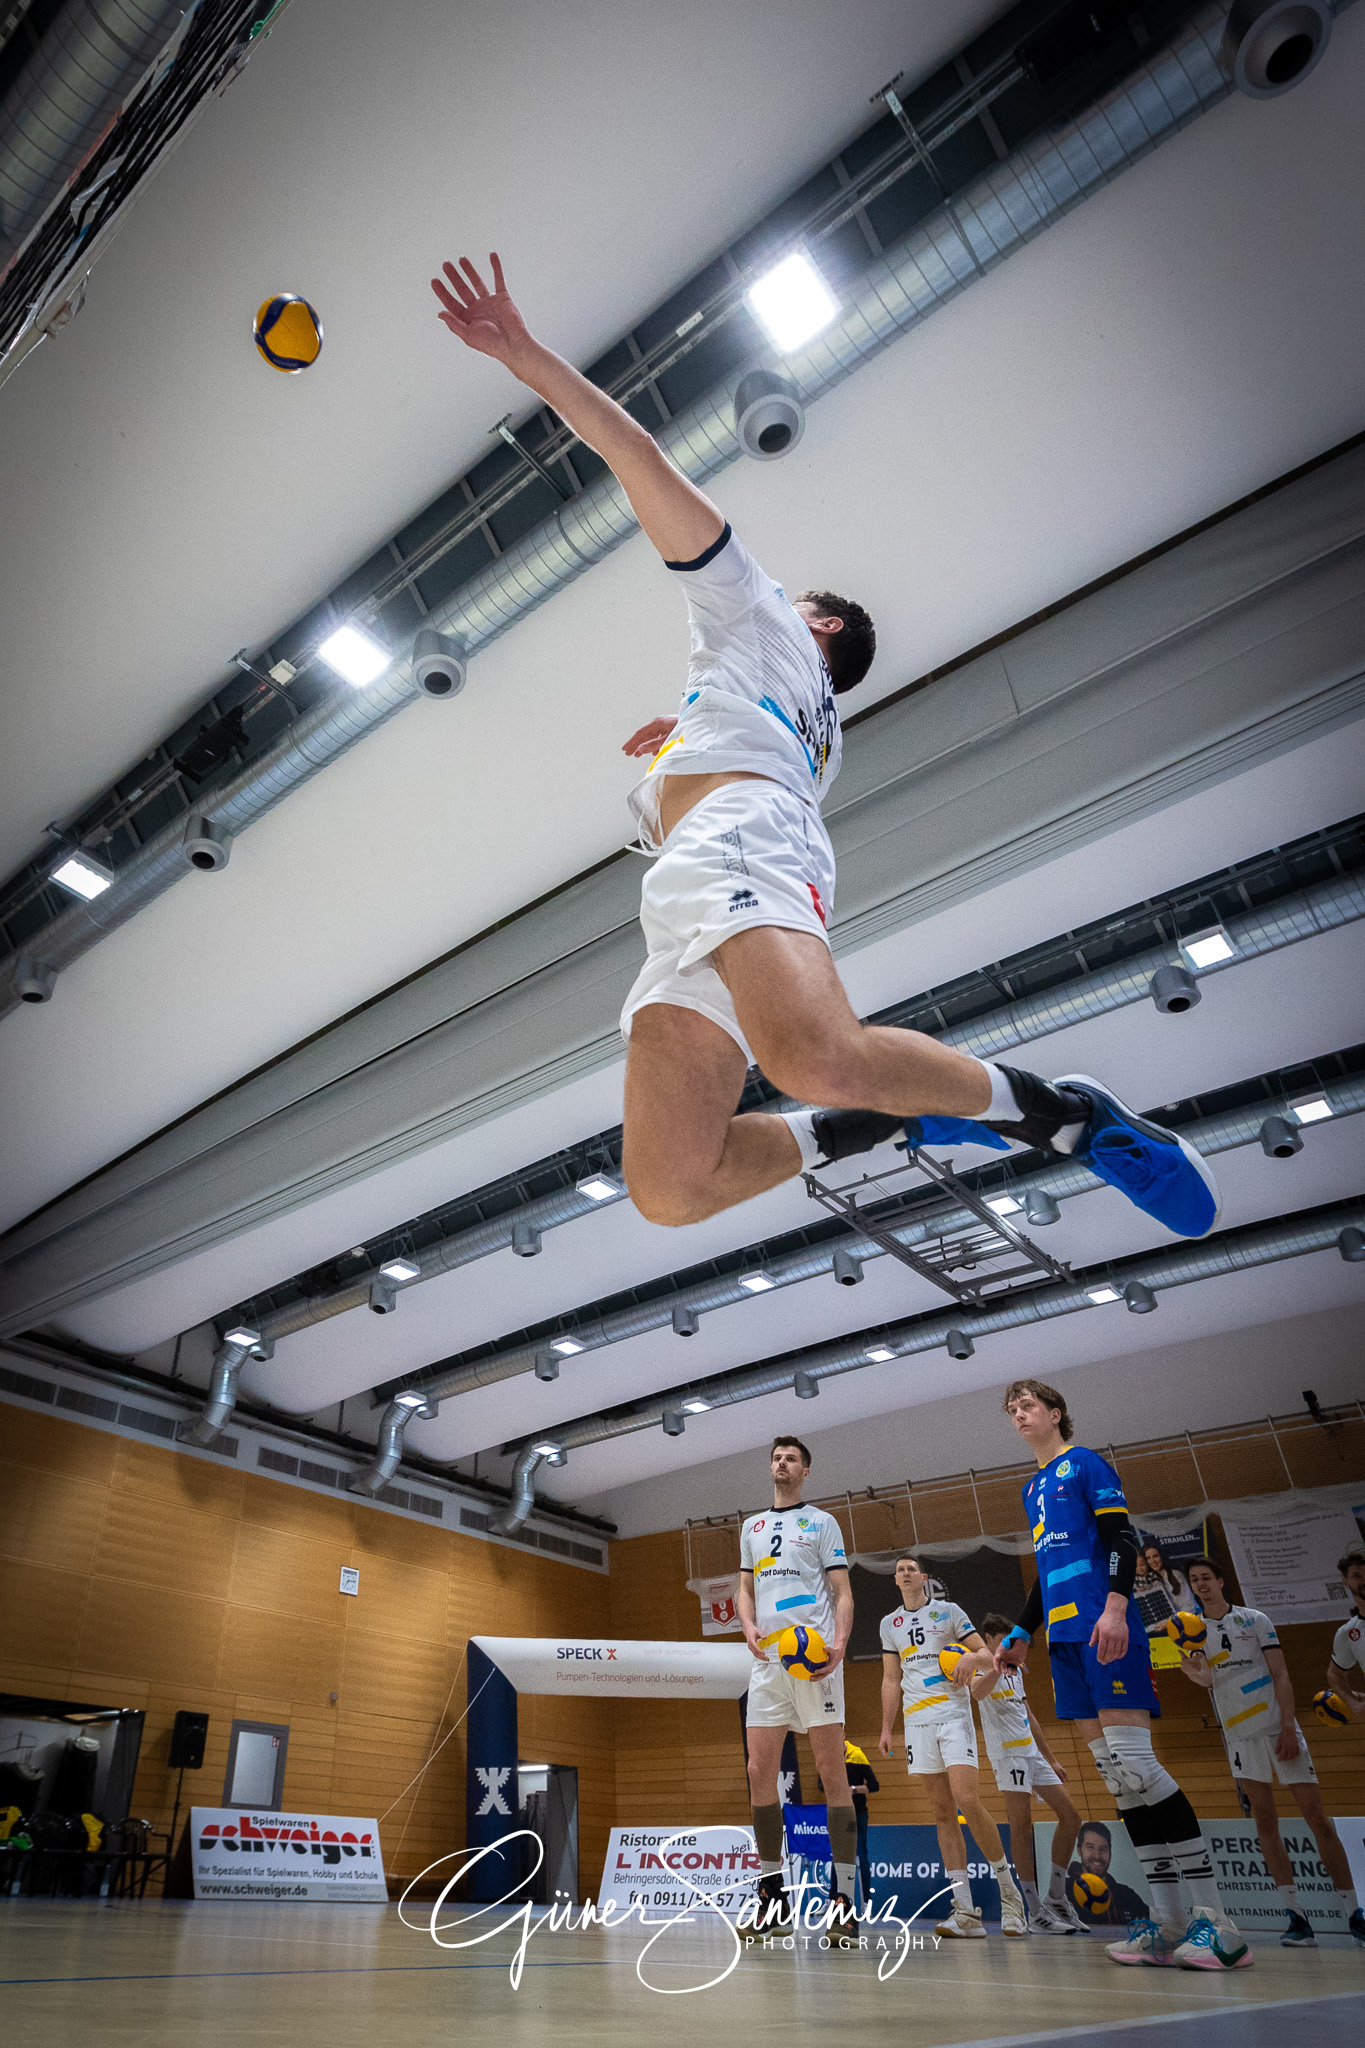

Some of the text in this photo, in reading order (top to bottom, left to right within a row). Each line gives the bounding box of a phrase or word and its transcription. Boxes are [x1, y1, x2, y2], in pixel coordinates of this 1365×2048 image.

[729, 899, 759, 912] errea
[1037, 1493, 1046, 1523] 3
[770, 1535, 782, 1557] 2
[908, 1627, 926, 1647] 15
[1221, 1634, 1232, 1652] 4
[556, 1648, 602, 1660] SPECK
[556, 1672, 704, 1685] Pumpen-Technologien und -Lösungen
[1234, 1752, 1242, 1770] 4
[1010, 1768, 1025, 1786] 17
[252, 1816, 310, 1828] Spielwaren
[212, 1865, 252, 1878] Spezialist
[254, 1866, 265, 1877] für
[312, 1870, 337, 1880] Hobby
[338, 1870, 352, 1880] und
[354, 1870, 378, 1880] Schule
[916, 1862, 940, 1879] OF
[690, 1873, 722, 1886] Straße
[724, 1874, 732, 1885] 6
[1216, 1881, 1278, 1892] CHRISTIAN
[200, 1884, 308, 1898] www.schweiger.de
[716, 1892, 734, 1907] 57
